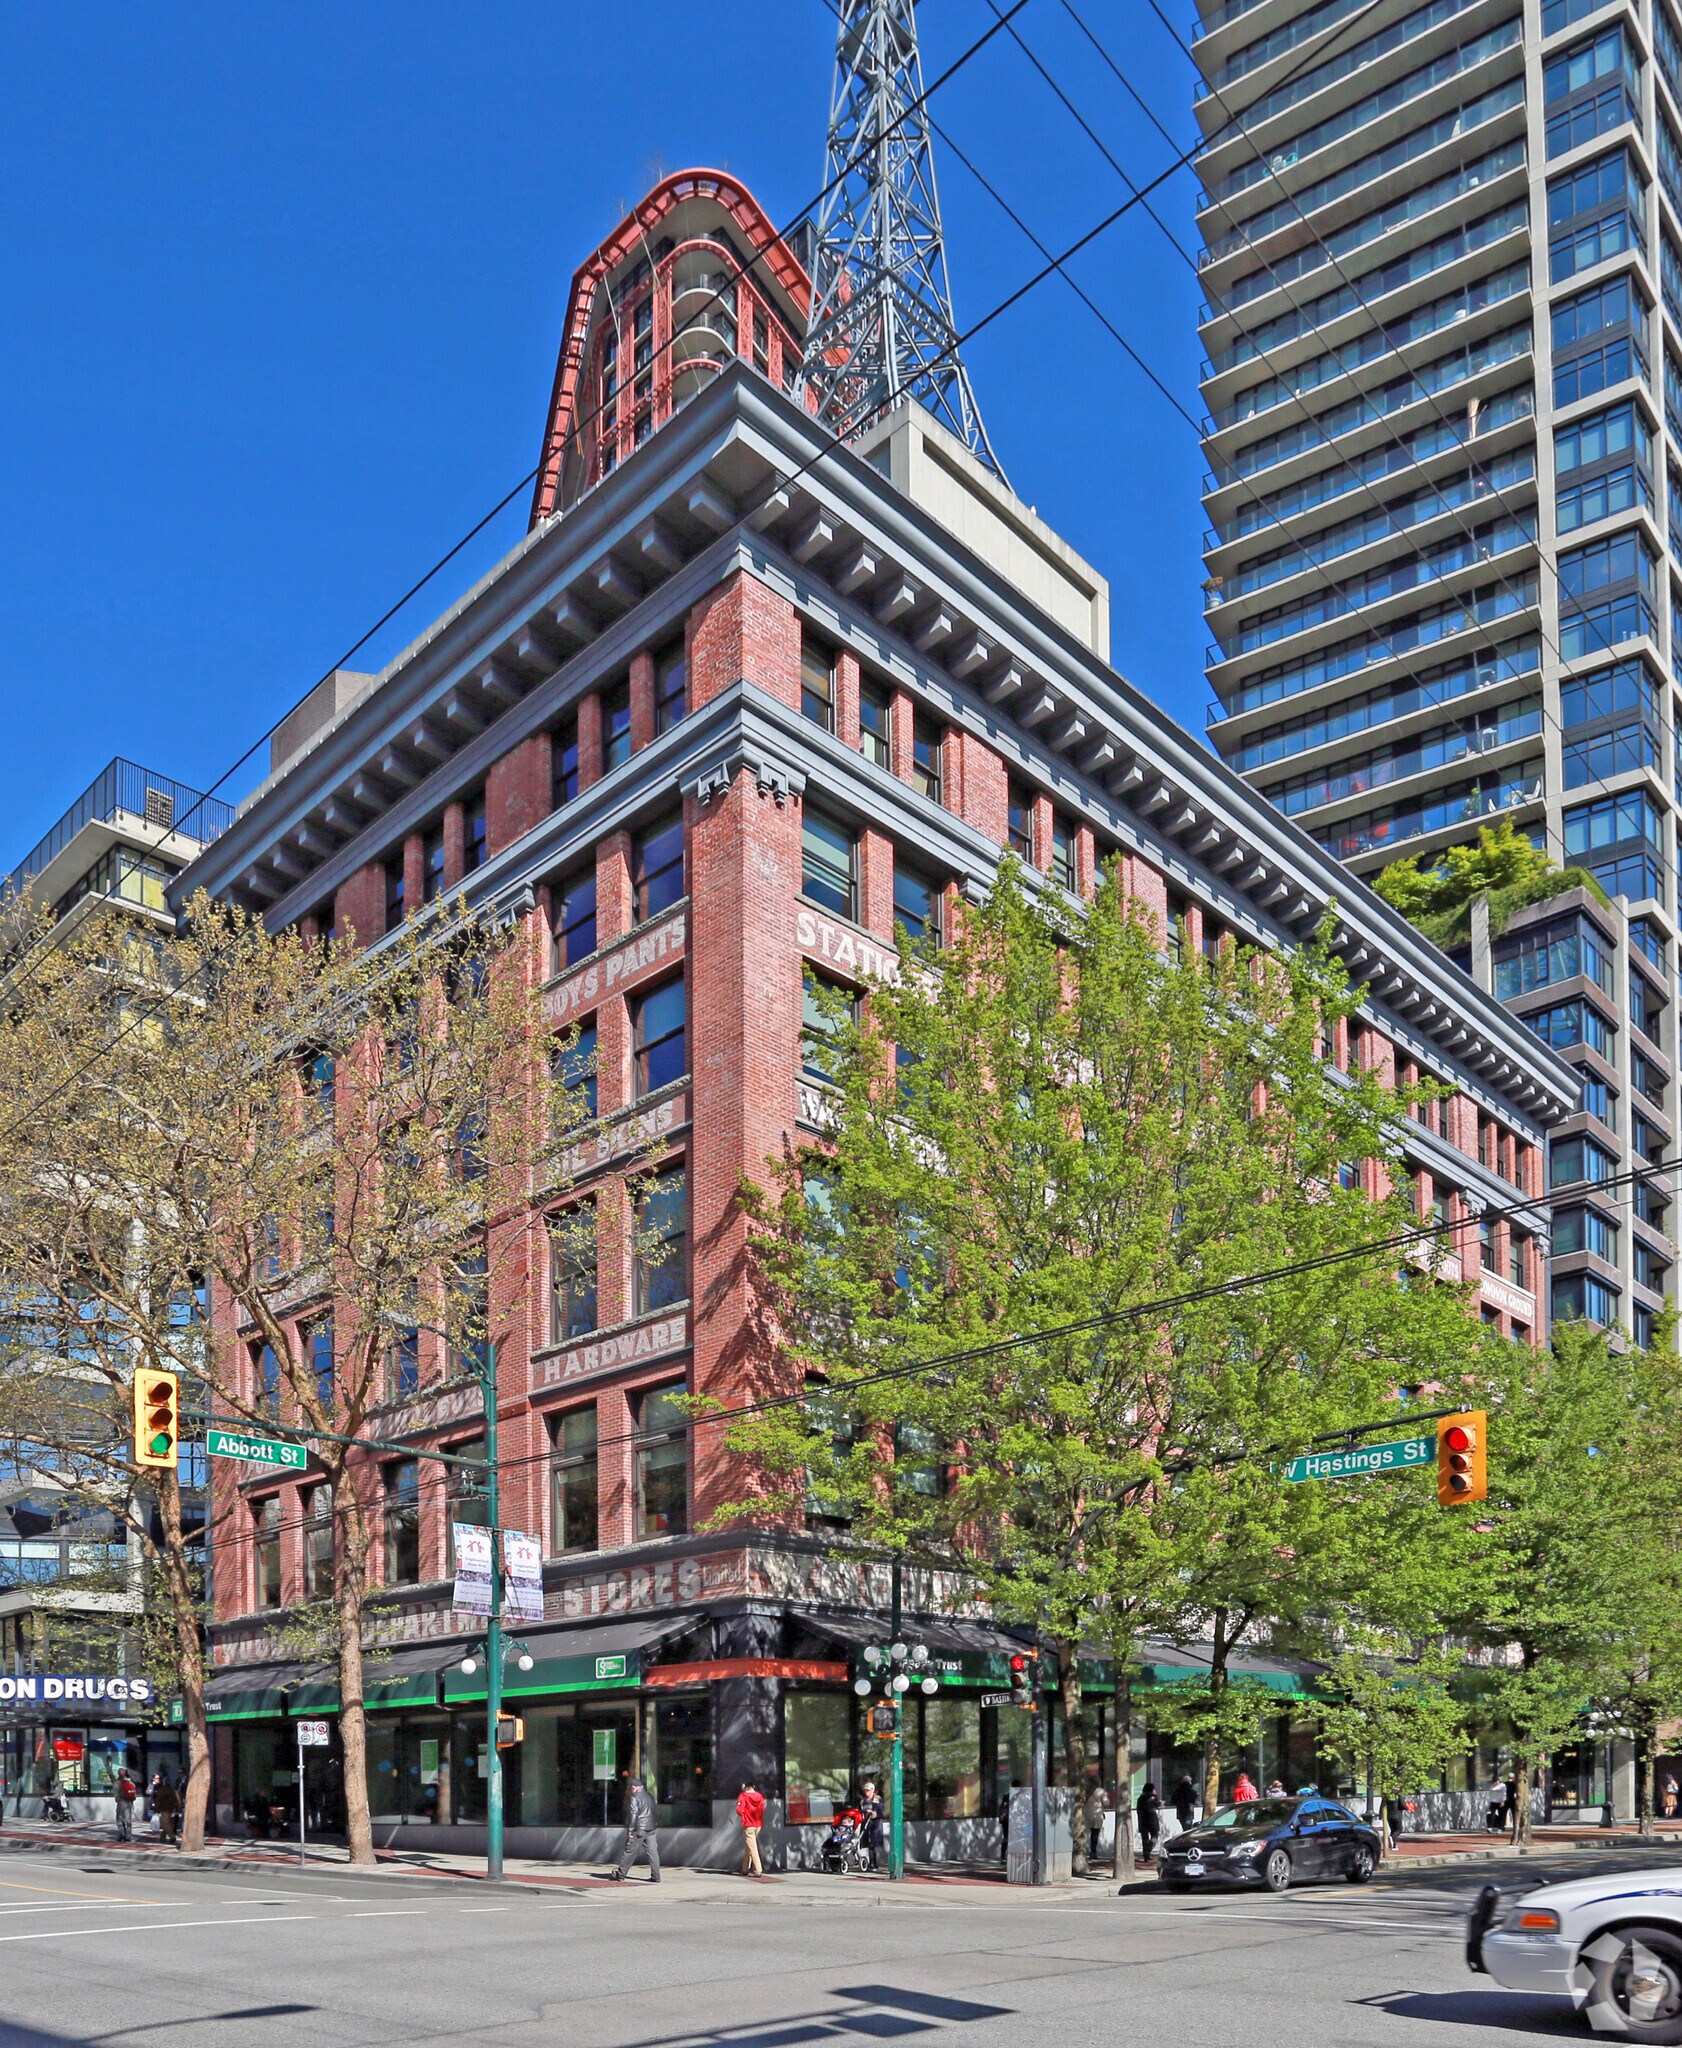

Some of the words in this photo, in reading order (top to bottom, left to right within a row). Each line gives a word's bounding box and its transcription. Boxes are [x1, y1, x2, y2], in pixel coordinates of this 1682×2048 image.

[541, 967, 598, 1024] BOYS
[606, 912, 685, 987] PANTS
[544, 1315, 685, 1383] HARDWARE
[217, 1437, 273, 1460] Abbott
[280, 1447, 298, 1464] St
[1306, 1449, 1393, 1476] Hastings
[1404, 1442, 1426, 1460] St
[564, 1558, 700, 1616] STORES
[702, 1558, 743, 1587] Limited
[936, 1659, 962, 1670] Trust
[43, 1678, 149, 1700] DRUGS
[205, 1701, 222, 1711] Trust
